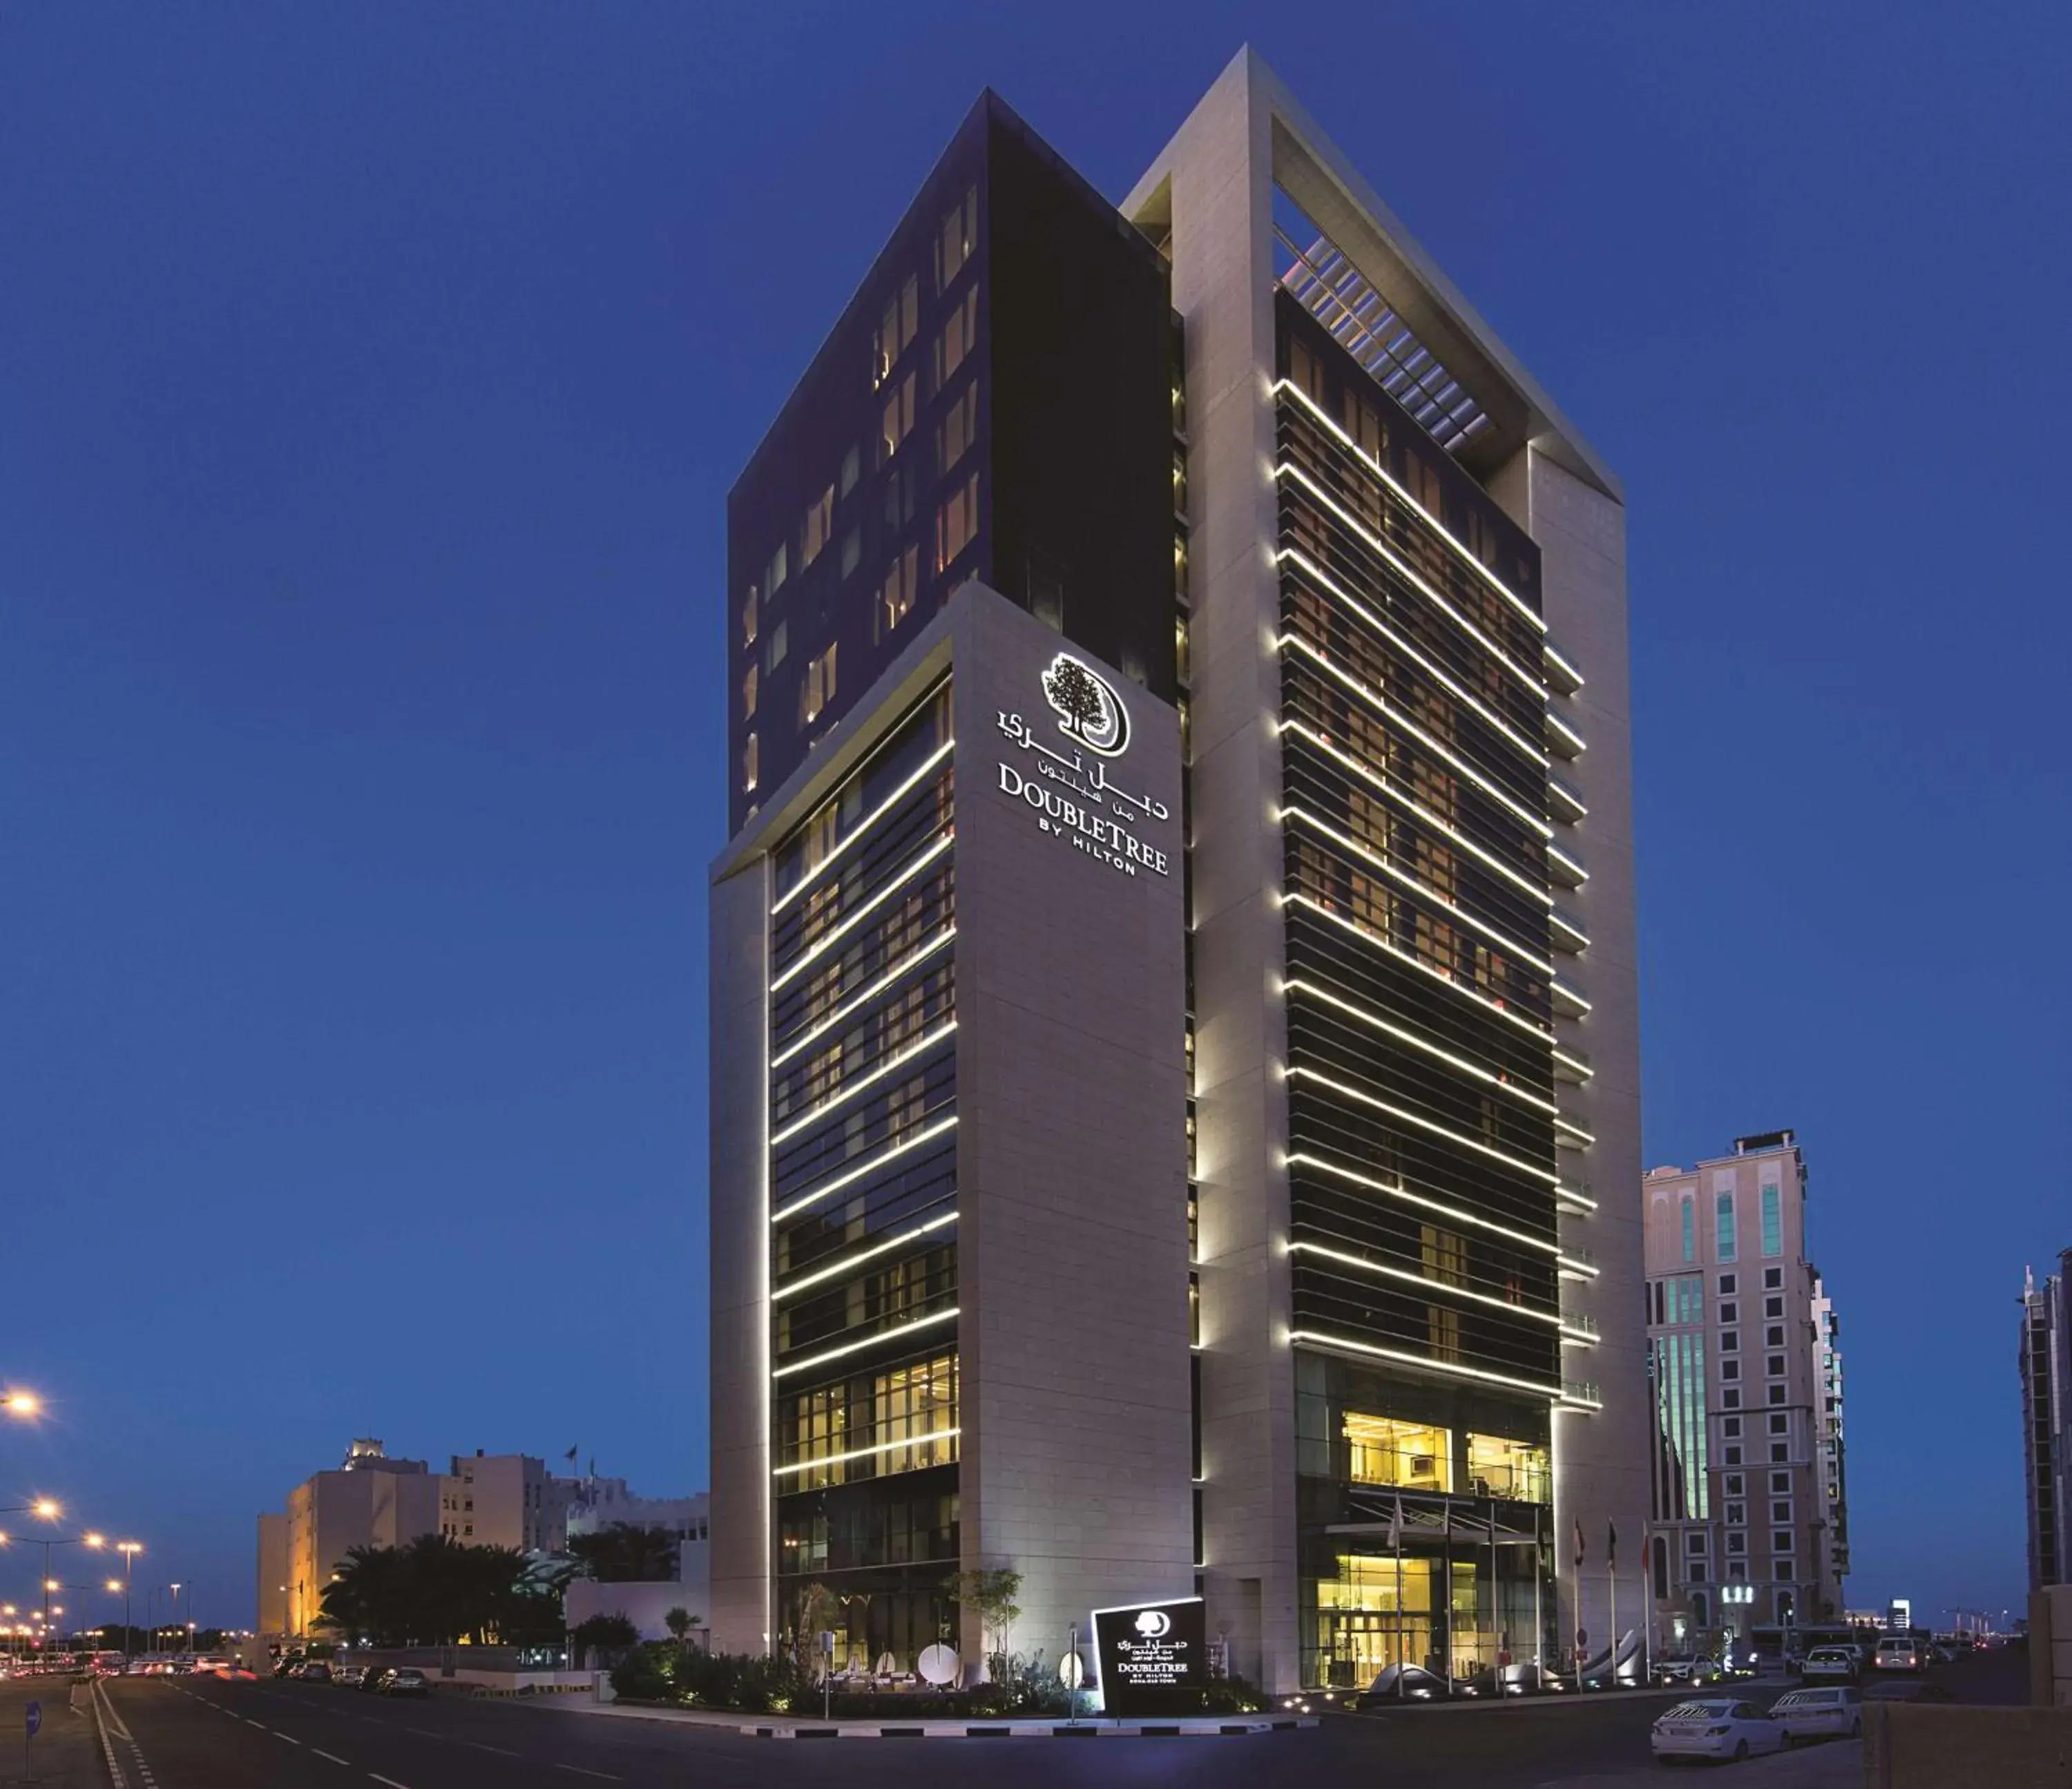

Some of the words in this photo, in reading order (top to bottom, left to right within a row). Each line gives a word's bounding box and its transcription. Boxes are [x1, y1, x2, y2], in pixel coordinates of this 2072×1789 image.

[997, 711, 1082, 772] تري
[1038, 760, 1102, 803] هيلتون
[999, 762, 1169, 875] DOUBLETREE
[1113, 802, 1135, 821] من
[1039, 817, 1062, 836] BY
[1073, 834, 1135, 877] HILTON
[1118, 1663, 1188, 1672] DOUBLETREE
